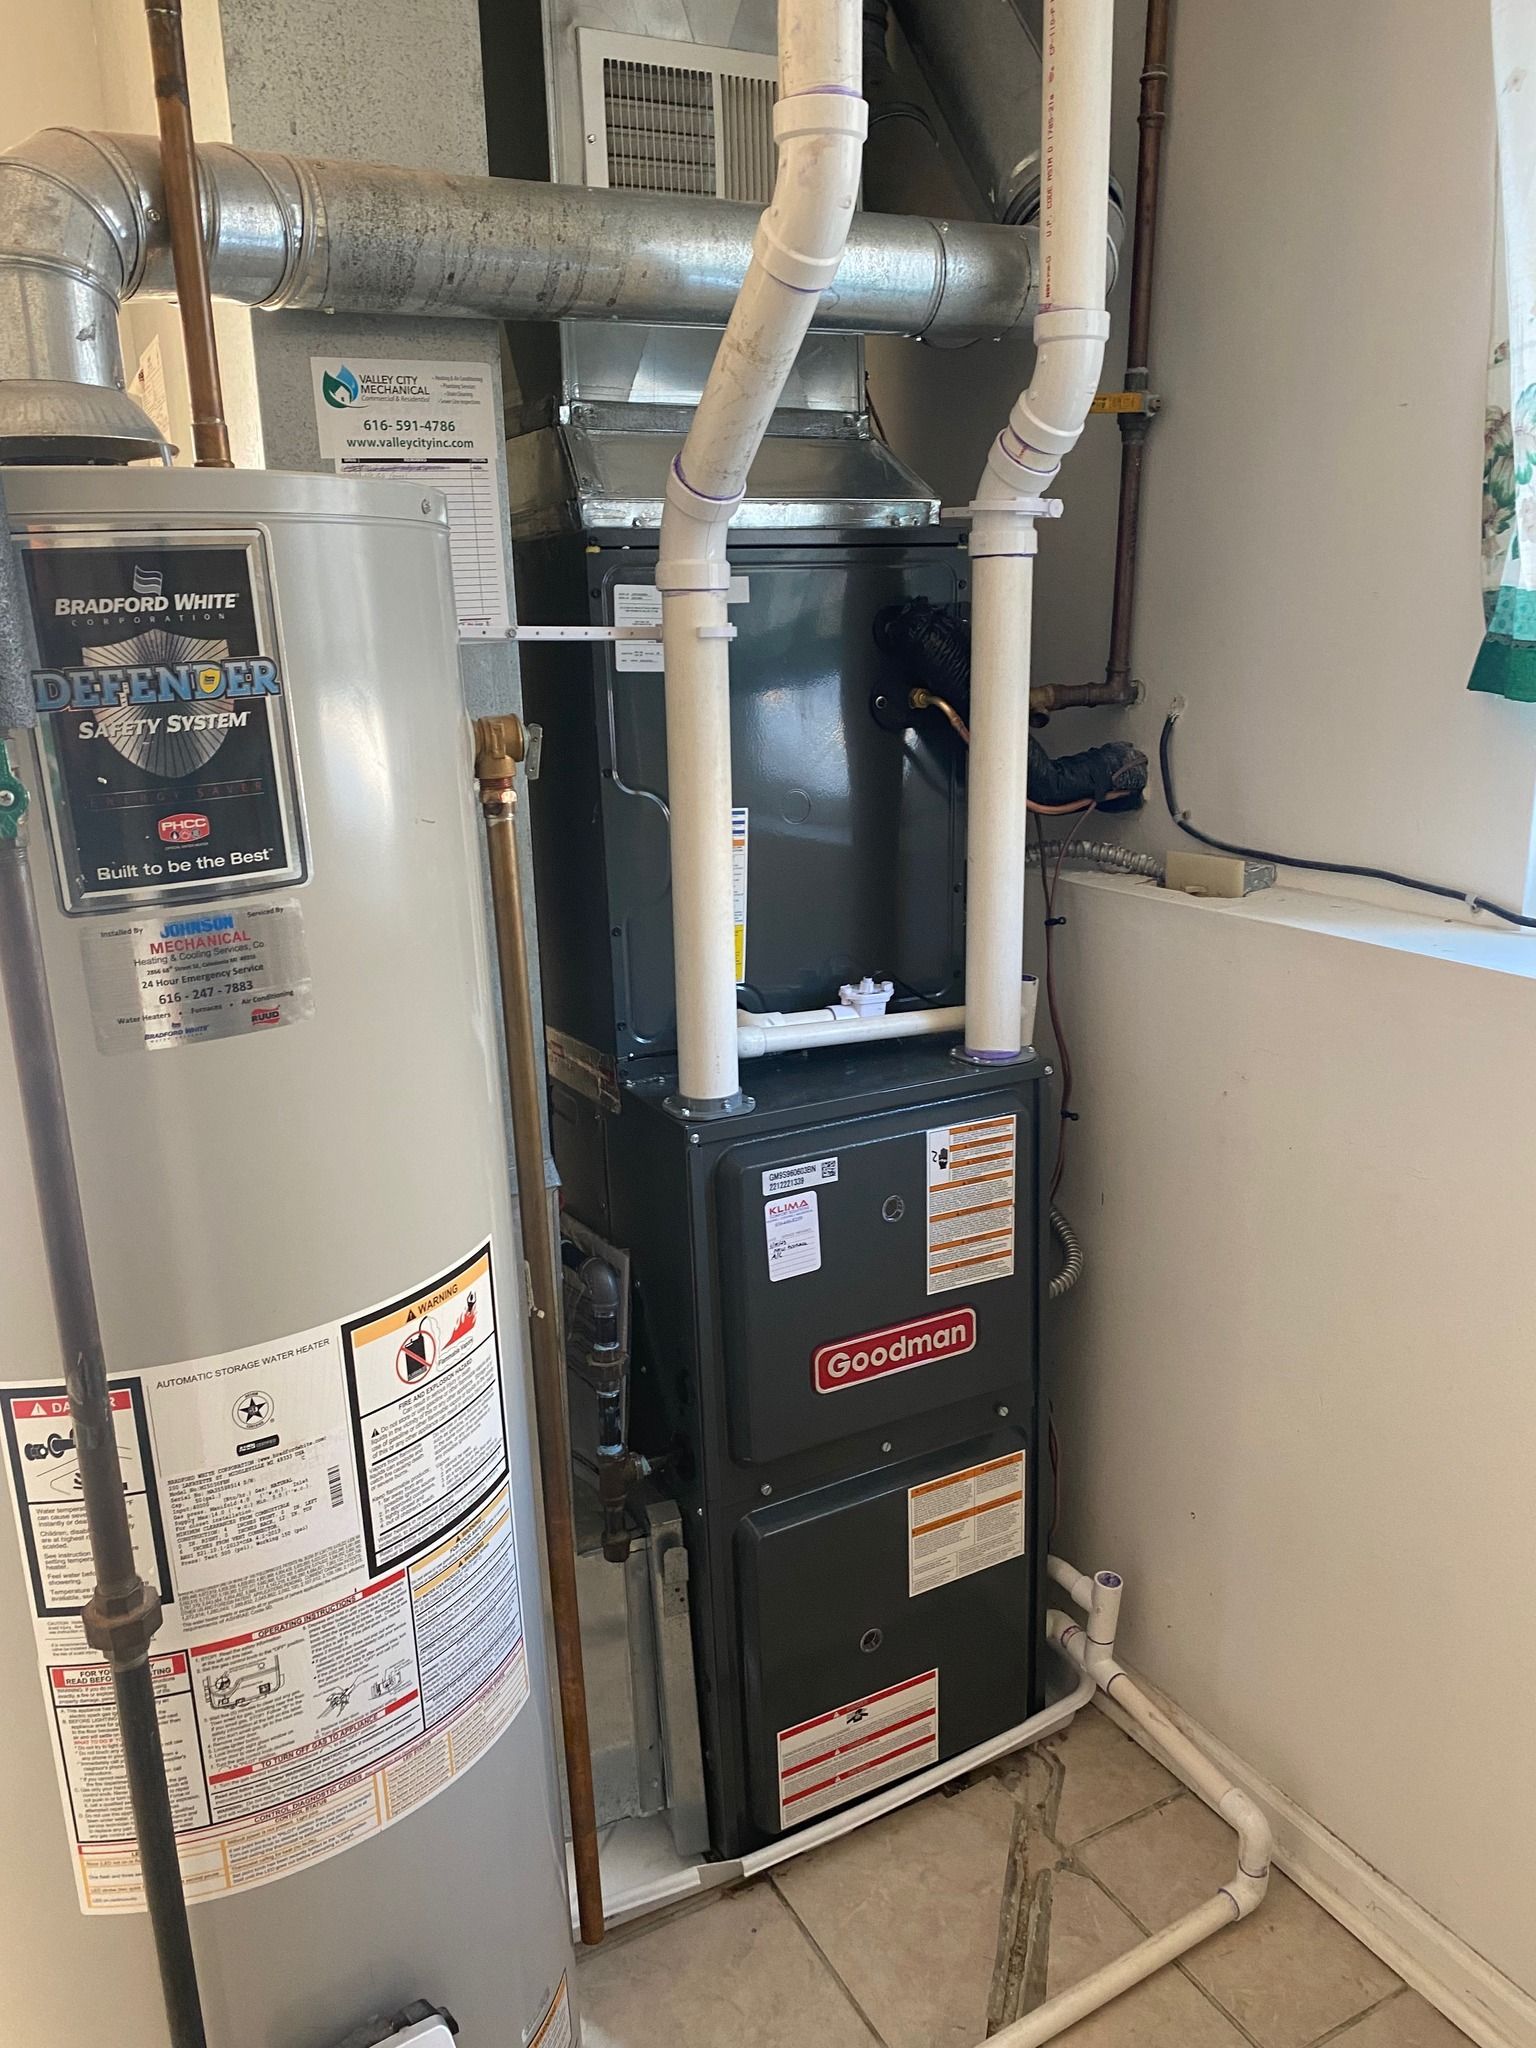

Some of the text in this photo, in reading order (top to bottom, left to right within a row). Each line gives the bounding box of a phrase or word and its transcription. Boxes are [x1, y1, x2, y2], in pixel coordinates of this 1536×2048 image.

[1046, 157, 1054, 181] ASTM
[359, 375, 418, 385] VALLEY CITY
[360, 385, 430, 395] MECHANICAL
[346, 437, 474, 450] www.valleycityinc.com
[55, 592, 237, 616] BRADFORD WHITE
[71, 612, 225, 627] CORPORATION
[32, 656, 282, 712] DEFENDER
[79, 711, 248, 740] SAFETY SYSTEM
[161, 818, 208, 831] PHCC
[97, 849, 271, 881] Built to be the Best
[160, 915, 235, 939] JOHNSON
[149, 930, 251, 955] MECHANICAL
[134, 954, 168, 968] Heating
[170, 952, 177, 962] &
[179, 949, 212, 962] Cooling
[142, 964, 265, 989] 24 Hour Emergency Service
[159, 993, 182, 1005] 616
[192, 987, 214, 1000] 247
[225, 980, 254, 994] 7883
[117, 1017, 141, 1025] Water
[142, 1012, 171, 1022] Heaters
[241, 998, 251, 1006] Air
[252, 990, 294, 1004] Conditioning
[251, 1011, 280, 1022] RUUD
[144, 1029, 184, 1041] BRADFORD
[769, 1199, 809, 1215] KLIMA
[417, 1283, 458, 1315] WARNING
[827, 1323, 967, 1379] Goodman
[156, 1338, 330, 1389] AUTOMATIC STORAGE WATER HEATER
[426, 1372, 454, 1394] EXPLOSION
[258, 1595, 356, 1638] OPERATING INSTRUCTIONS
[66, 1677, 88, 1685] READ
[261, 1759, 271, 1768] TO
[274, 1752, 294, 1764] TURN
[295, 1745, 310, 1755] OFF
[312, 1738, 328, 1749] GAS
[340, 1713, 380, 1739] APPLIANCE
[254, 1774, 363, 1823] CONTROL DIAGNOSTIC CODES
